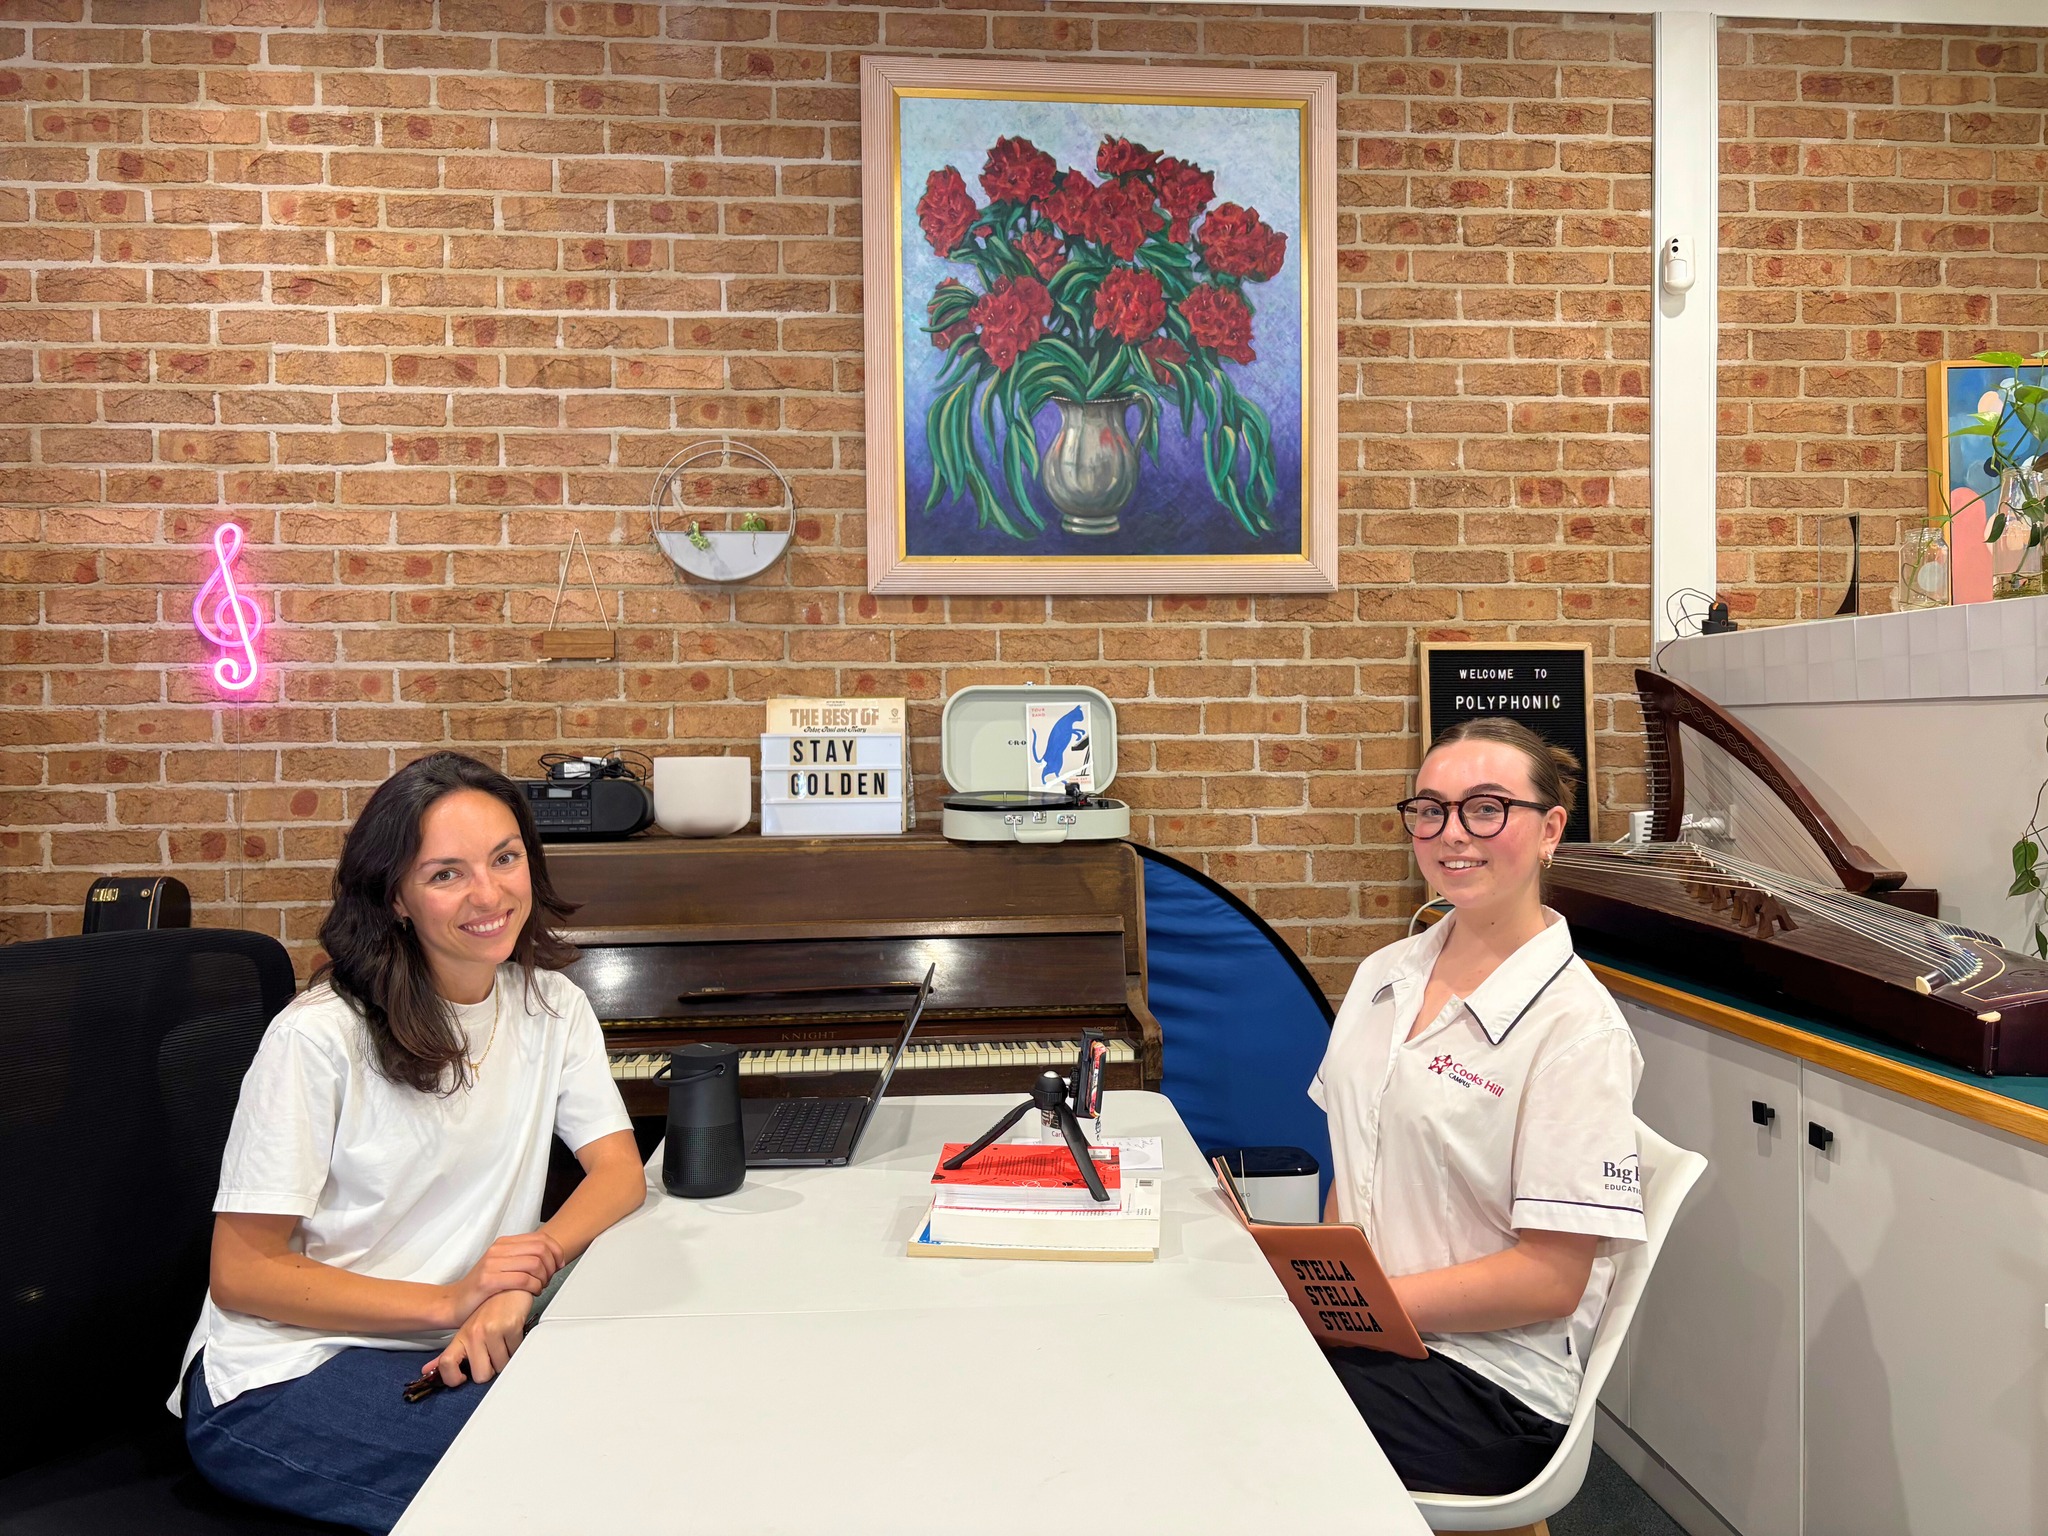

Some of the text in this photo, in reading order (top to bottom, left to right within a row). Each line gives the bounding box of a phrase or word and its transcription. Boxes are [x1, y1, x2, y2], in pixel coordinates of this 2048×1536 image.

[1459, 668, 1548, 680] WELCOME TO
[1455, 695, 1561, 710] POLYPHONIC
[790, 708, 880, 727] THE BEST OF
[793, 740, 854, 763] STAY
[791, 772, 885, 795] GOLDEN
[781, 1031, 838, 1041] KNIGHT
[1448, 1072, 1472, 1088] CAMPUS
[1452, 1063, 1505, 1098] Cooks Hill
[1602, 1161, 1633, 1184] Big
[1290, 1259, 1355, 1281] STELLA
[1304, 1285, 1369, 1307] STELLA
[1318, 1310, 1383, 1333] STELLA
